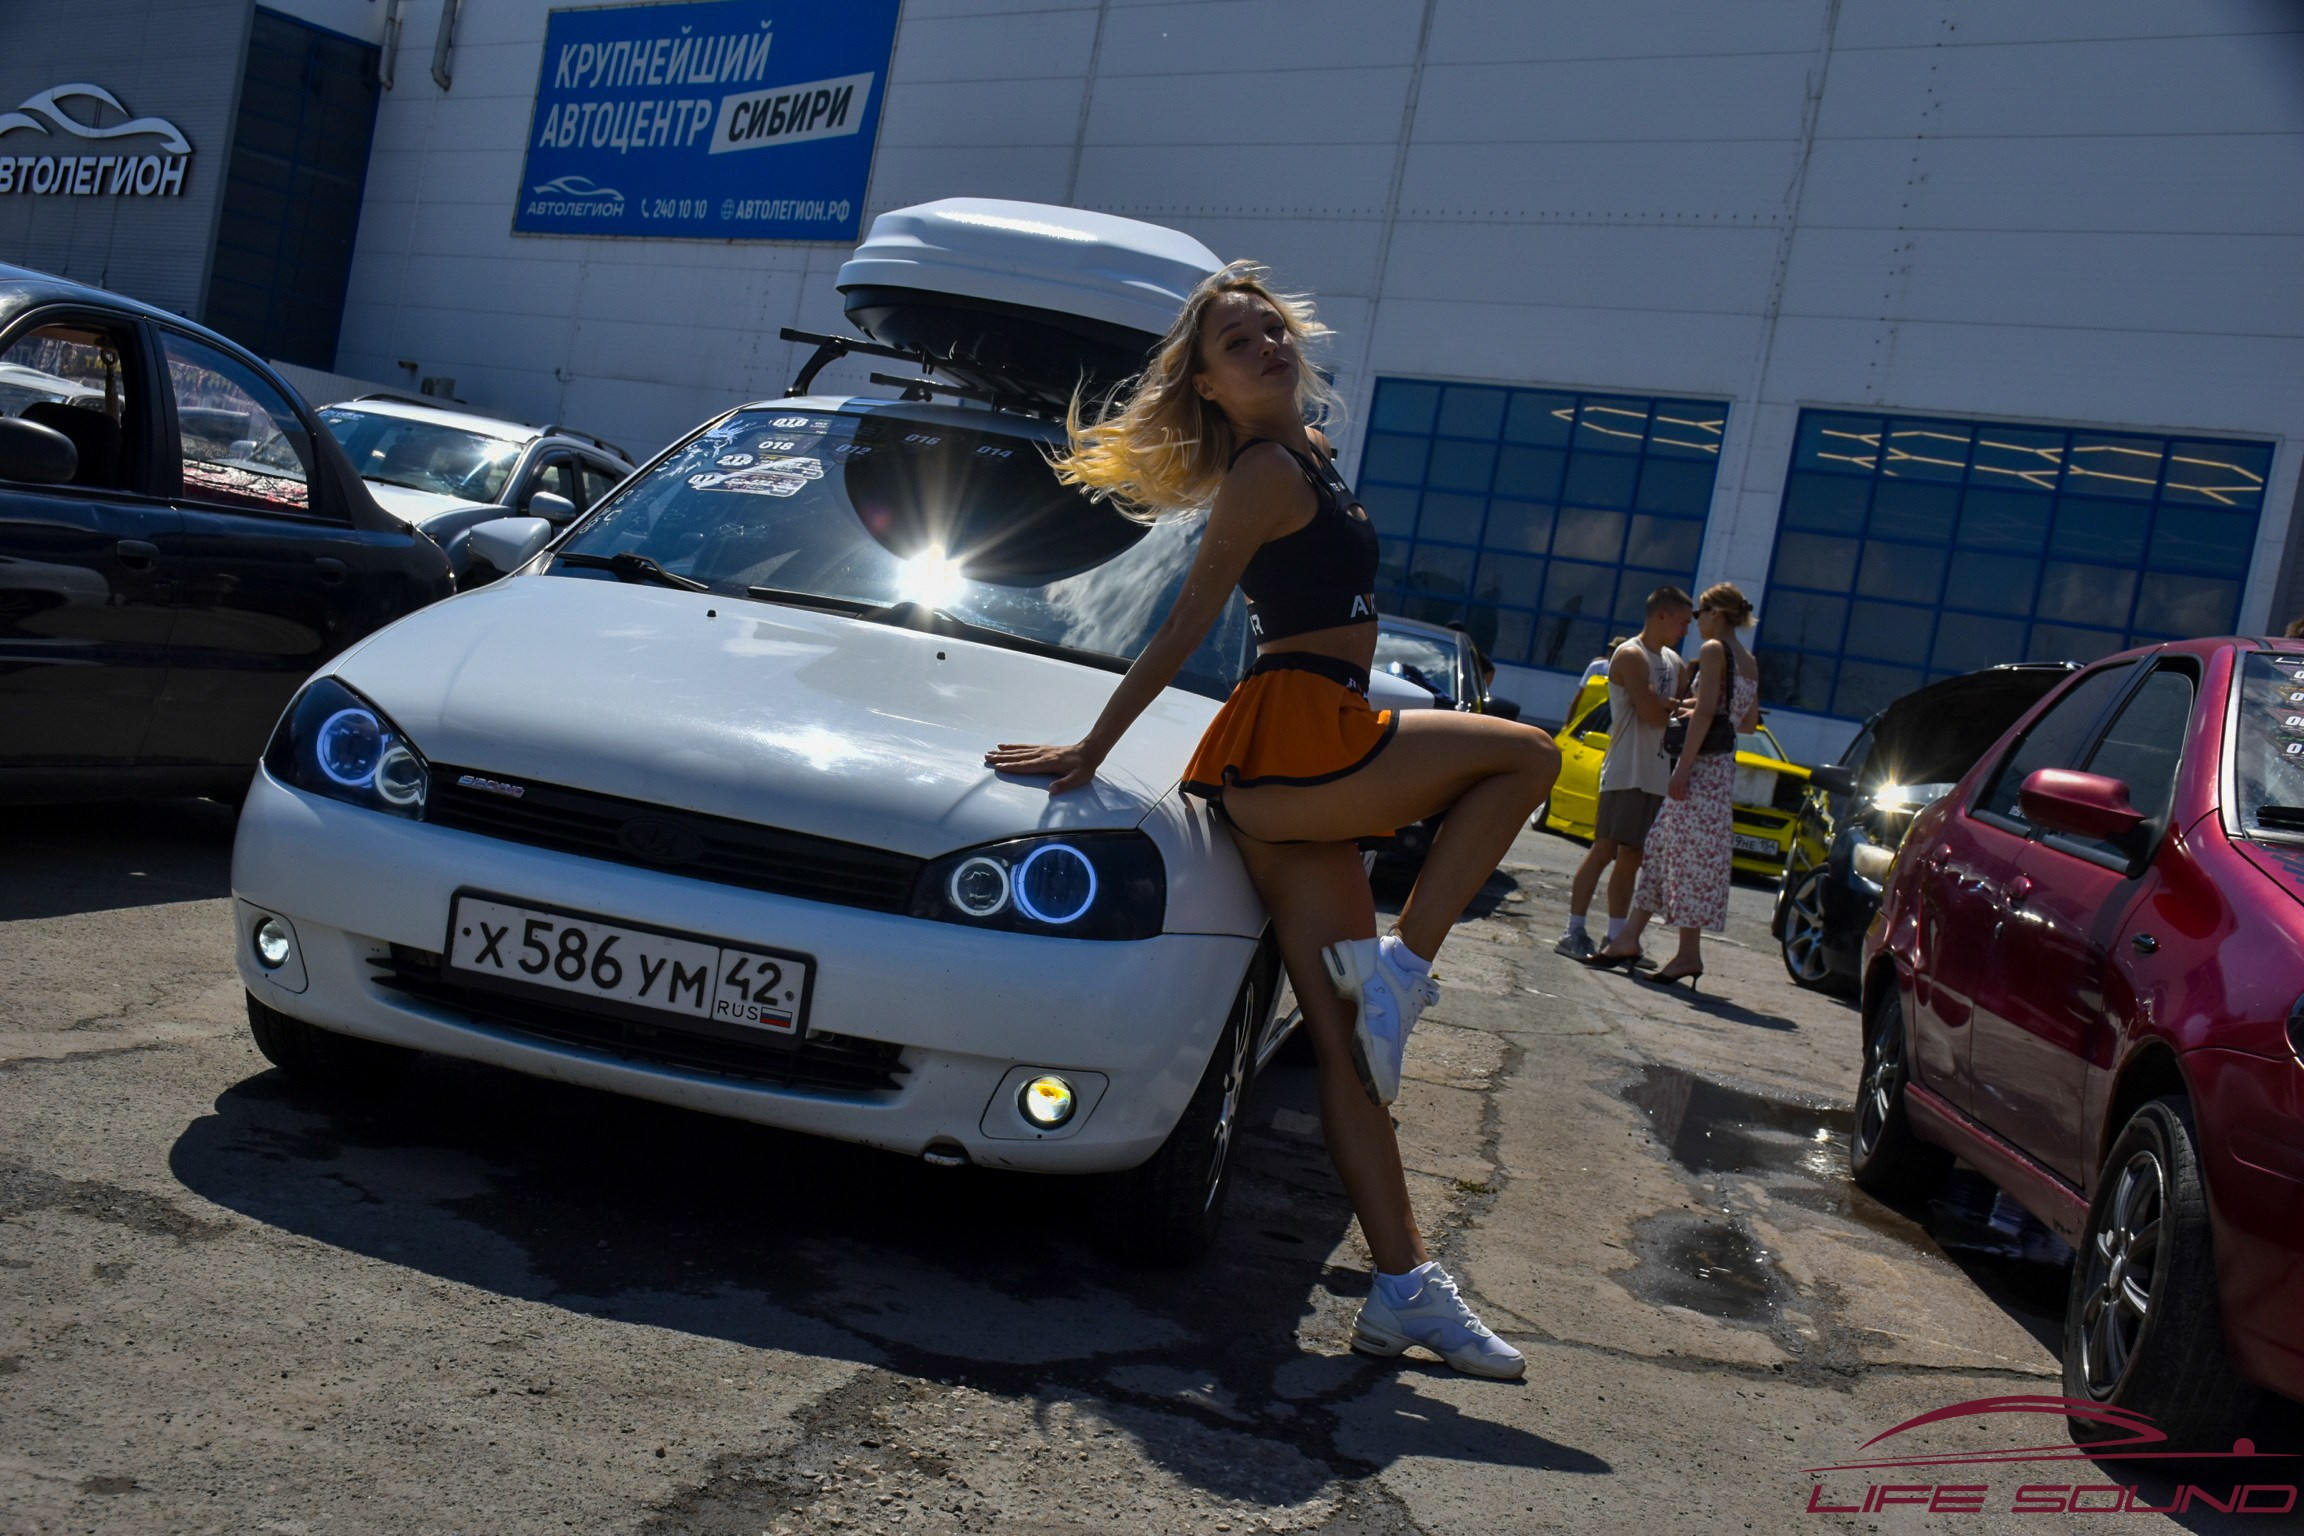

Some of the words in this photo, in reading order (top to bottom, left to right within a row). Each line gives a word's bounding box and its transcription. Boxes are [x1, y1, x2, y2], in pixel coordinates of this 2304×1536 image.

[554, 19, 773, 89] КРУПНЕЙШИЙ
[539, 99, 712, 154] АВТОЦЕНТР
[728, 85, 854, 142] СИБИРИ
[526, 201, 625, 217] АВТОЛЕГИОН
[653, 199, 676, 218] 240
[678, 199, 692, 218] 10
[694, 199, 708, 218] 10
[735, 199, 850, 223] АВТОЛЕГИОН.РФ
[758, 441, 795, 451] 018
[725, 957, 783, 1005] 42
[717, 1000, 758, 1021] RUS
